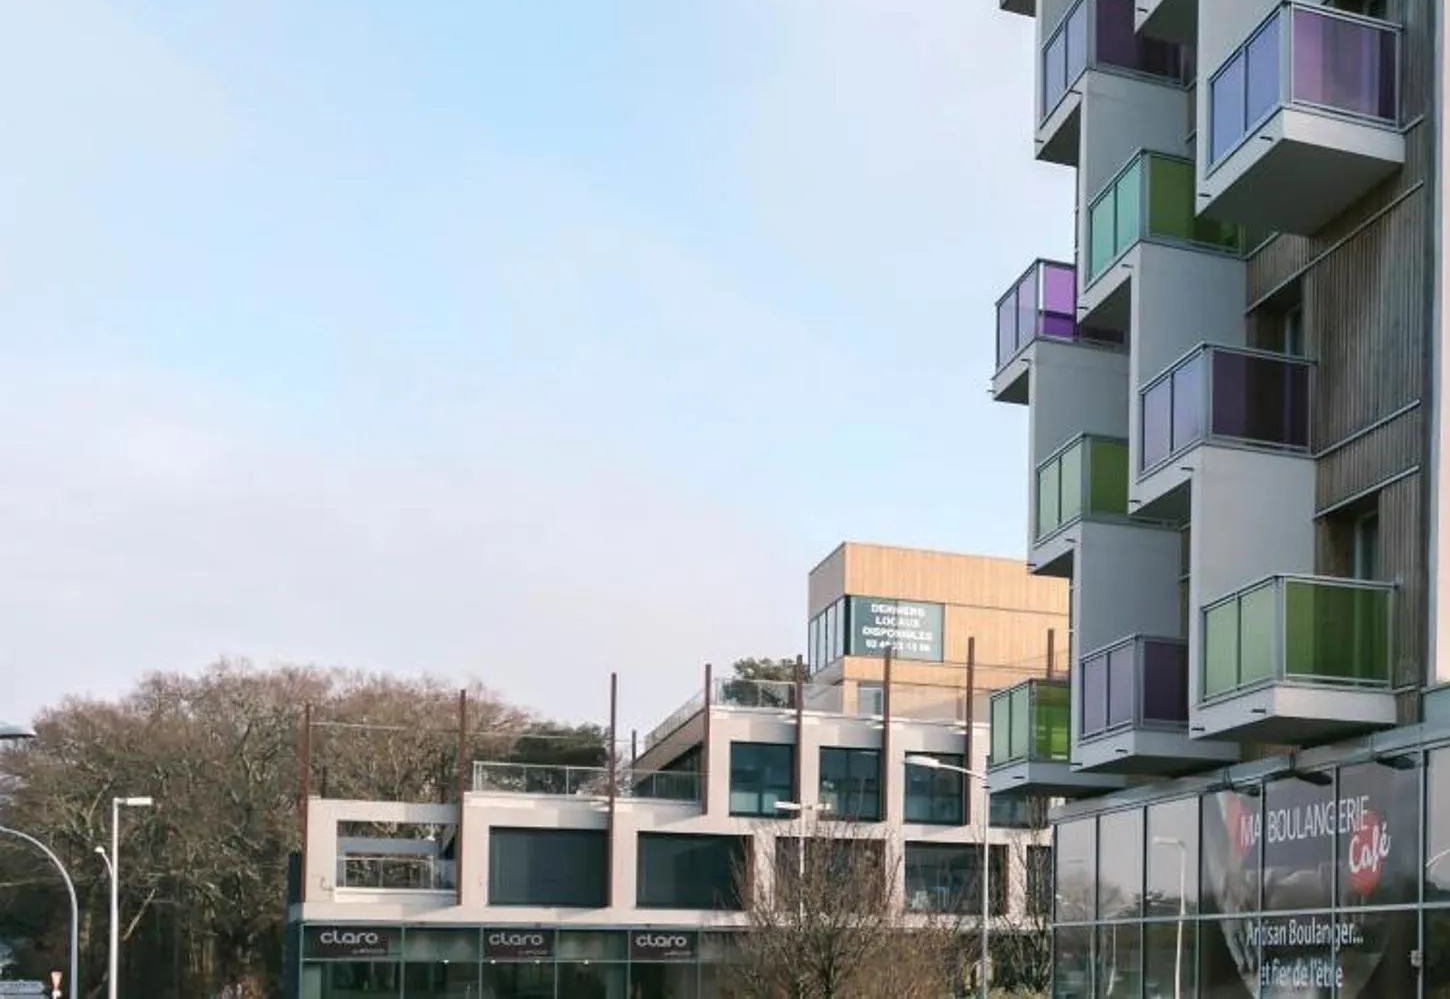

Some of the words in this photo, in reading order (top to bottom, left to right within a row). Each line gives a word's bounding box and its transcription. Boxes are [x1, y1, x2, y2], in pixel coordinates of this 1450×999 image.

[1268, 796, 1370, 844] BOULANGERIE
[1350, 821, 1392, 873] Café
[320, 930, 378, 945] claro
[488, 932, 544, 947] claro
[635, 934, 688, 948] claro
[1293, 957, 1309, 988] de
